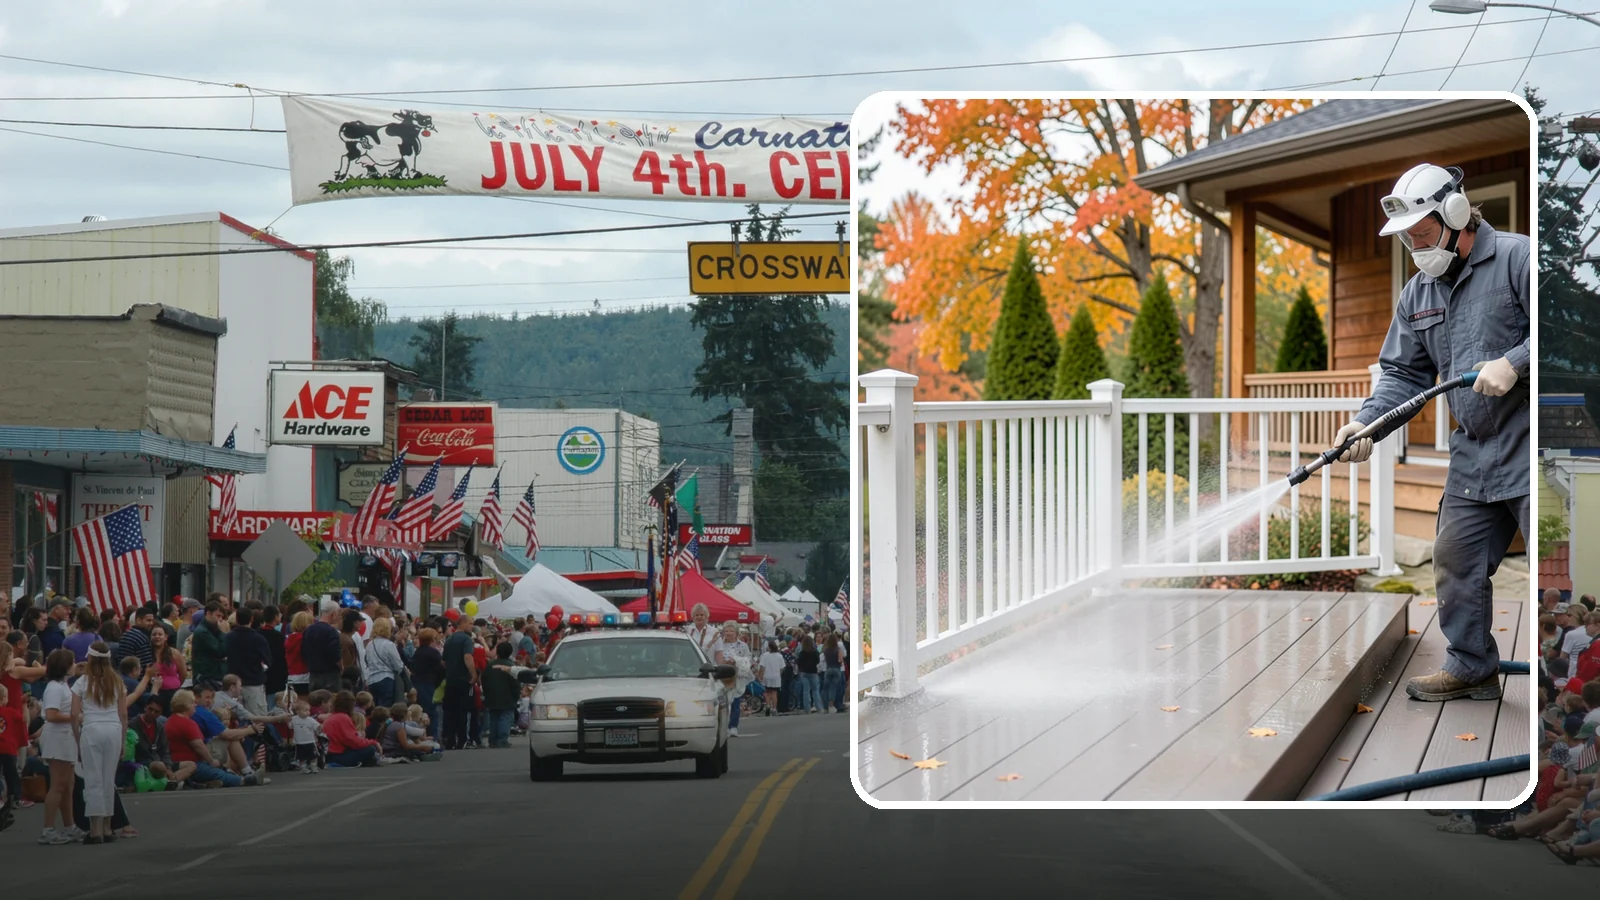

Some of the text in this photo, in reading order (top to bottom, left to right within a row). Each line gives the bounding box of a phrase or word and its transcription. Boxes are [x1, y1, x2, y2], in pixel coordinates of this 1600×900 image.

[695, 121, 849, 149] Carnat
[481, 141, 604, 192] JULY
[632, 150, 746, 197] 4th.
[697, 254, 849, 280] CROSSWA
[283, 380, 373, 420] ACE
[406, 409, 452, 422] CEDAR
[283, 421, 371, 436] Hardware
[416, 428, 477, 447] Coca-Cola
[96, 485, 124, 494] Vincent
[126, 486, 136, 495] de
[137, 486, 155, 495] Paul
[688, 526, 741, 535] CRNATION
[699, 535, 730, 544] GLASS
